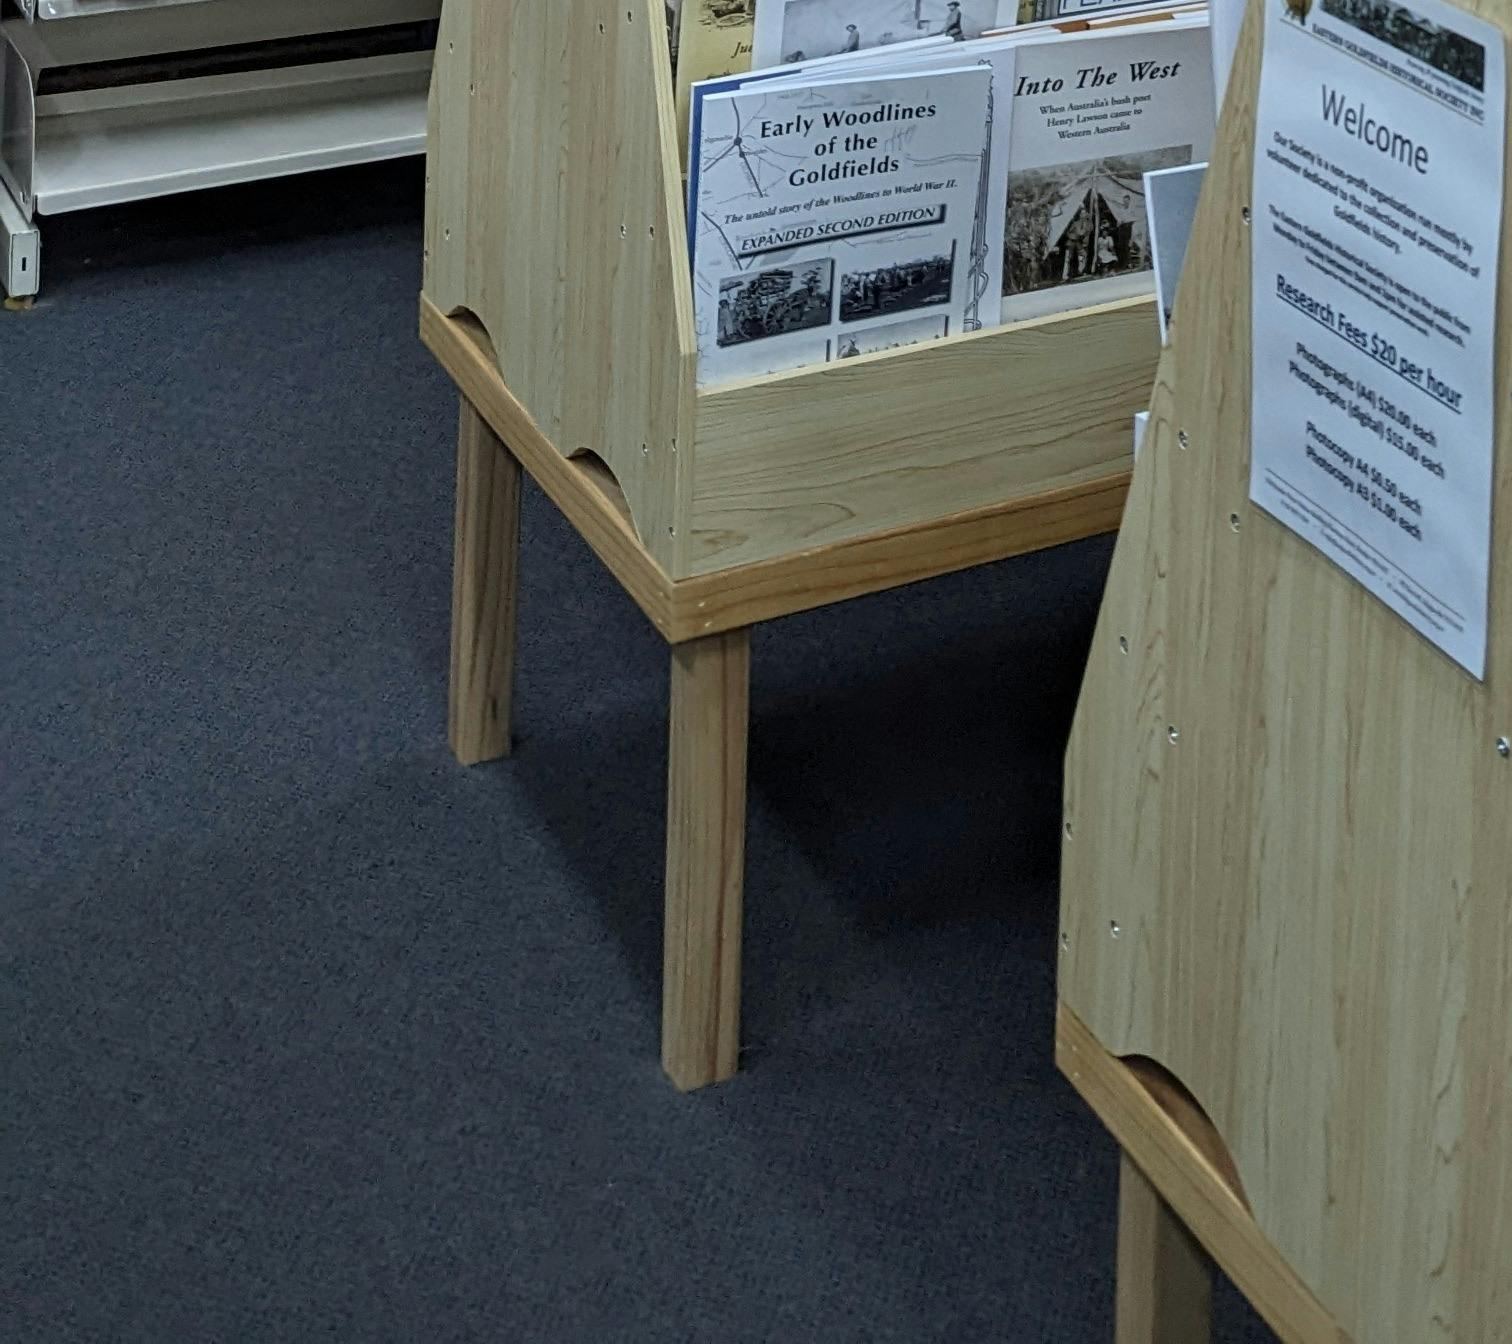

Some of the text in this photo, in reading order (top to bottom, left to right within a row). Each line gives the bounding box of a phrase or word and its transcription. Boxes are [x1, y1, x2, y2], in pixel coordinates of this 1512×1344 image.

[1014, 61, 1182, 97] Into The West
[761, 104, 937, 138] Early Woodlines
[1321, 83, 1429, 174] Welcome
[814, 133, 878, 156] of the
[789, 155, 900, 187] Goldfields
[742, 207, 935, 251] EXPANDED SECOND EDITION
[1276, 273, 1463, 408] Research Fees $20 per hour
